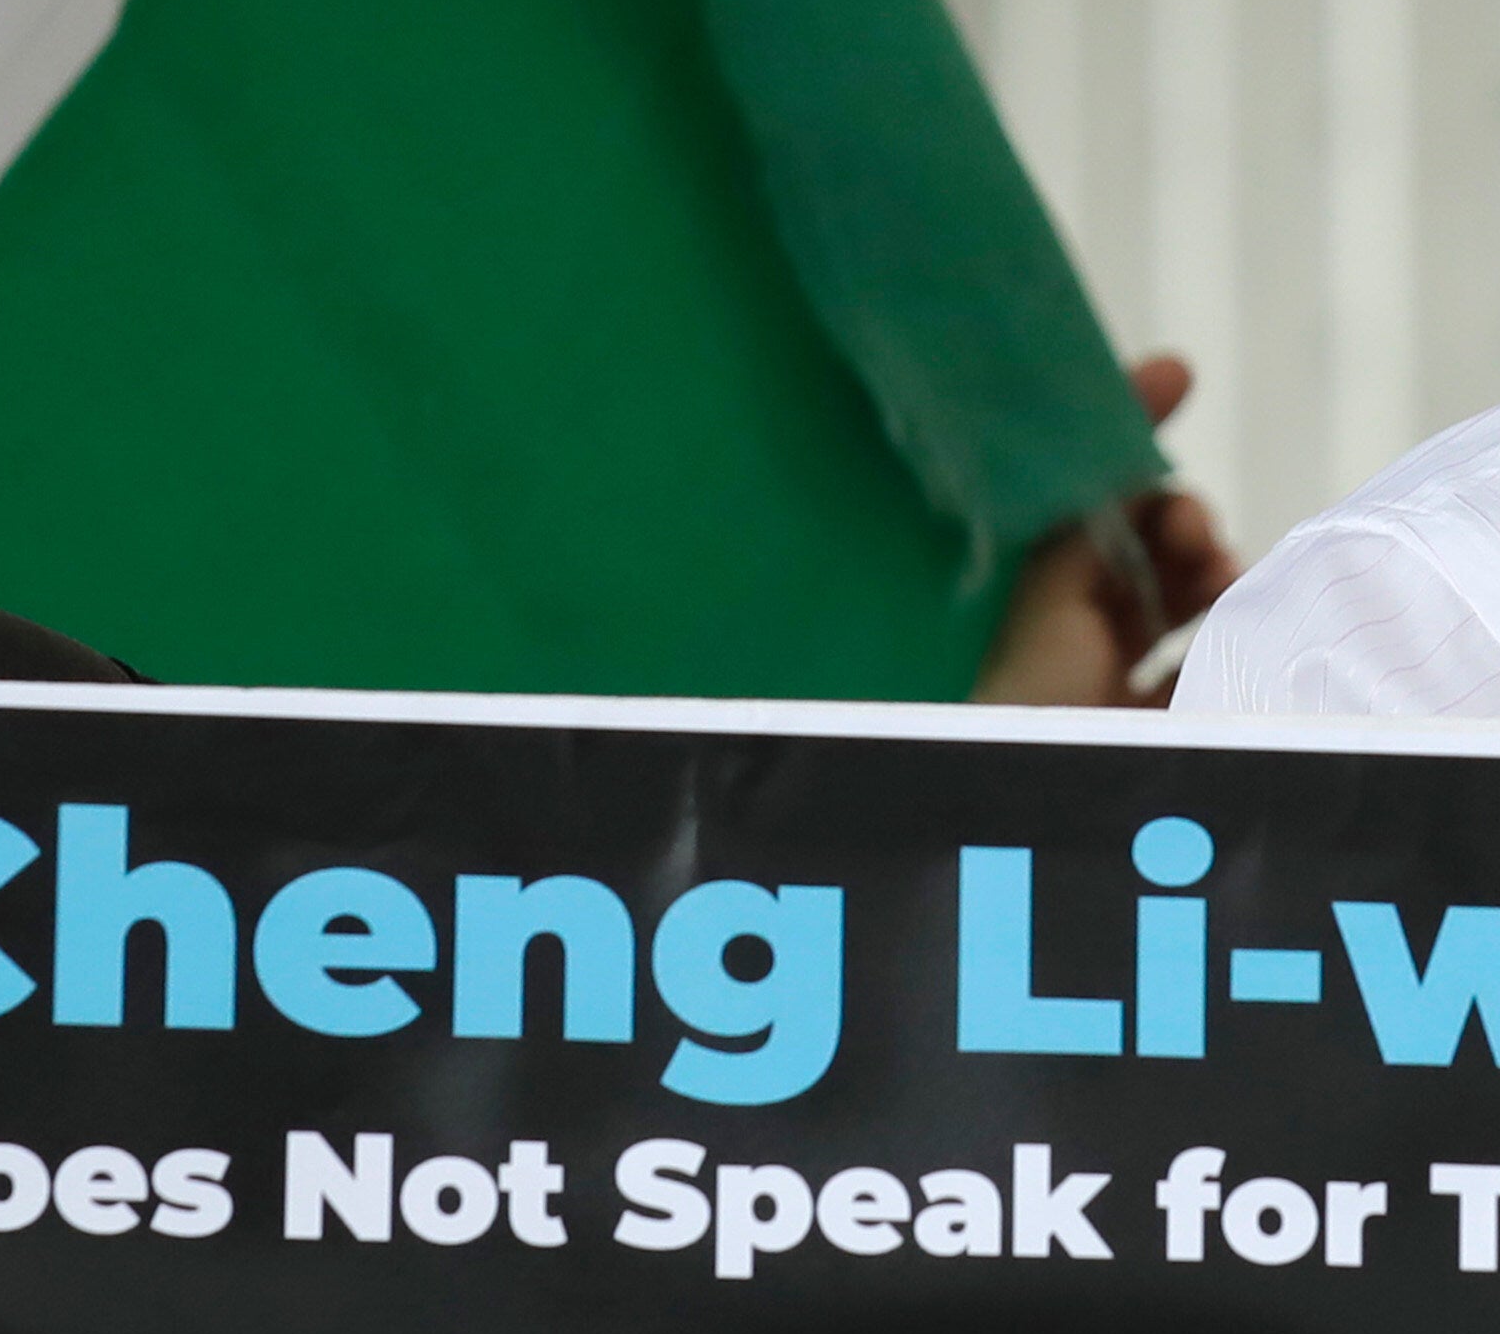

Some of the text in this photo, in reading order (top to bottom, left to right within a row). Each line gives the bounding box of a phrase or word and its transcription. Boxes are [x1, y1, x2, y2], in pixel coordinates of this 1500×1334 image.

[285, 1132, 566, 1246] Not
[615, 1139, 1112, 1278] Speak
[1157, 1147, 1386, 1266] for
